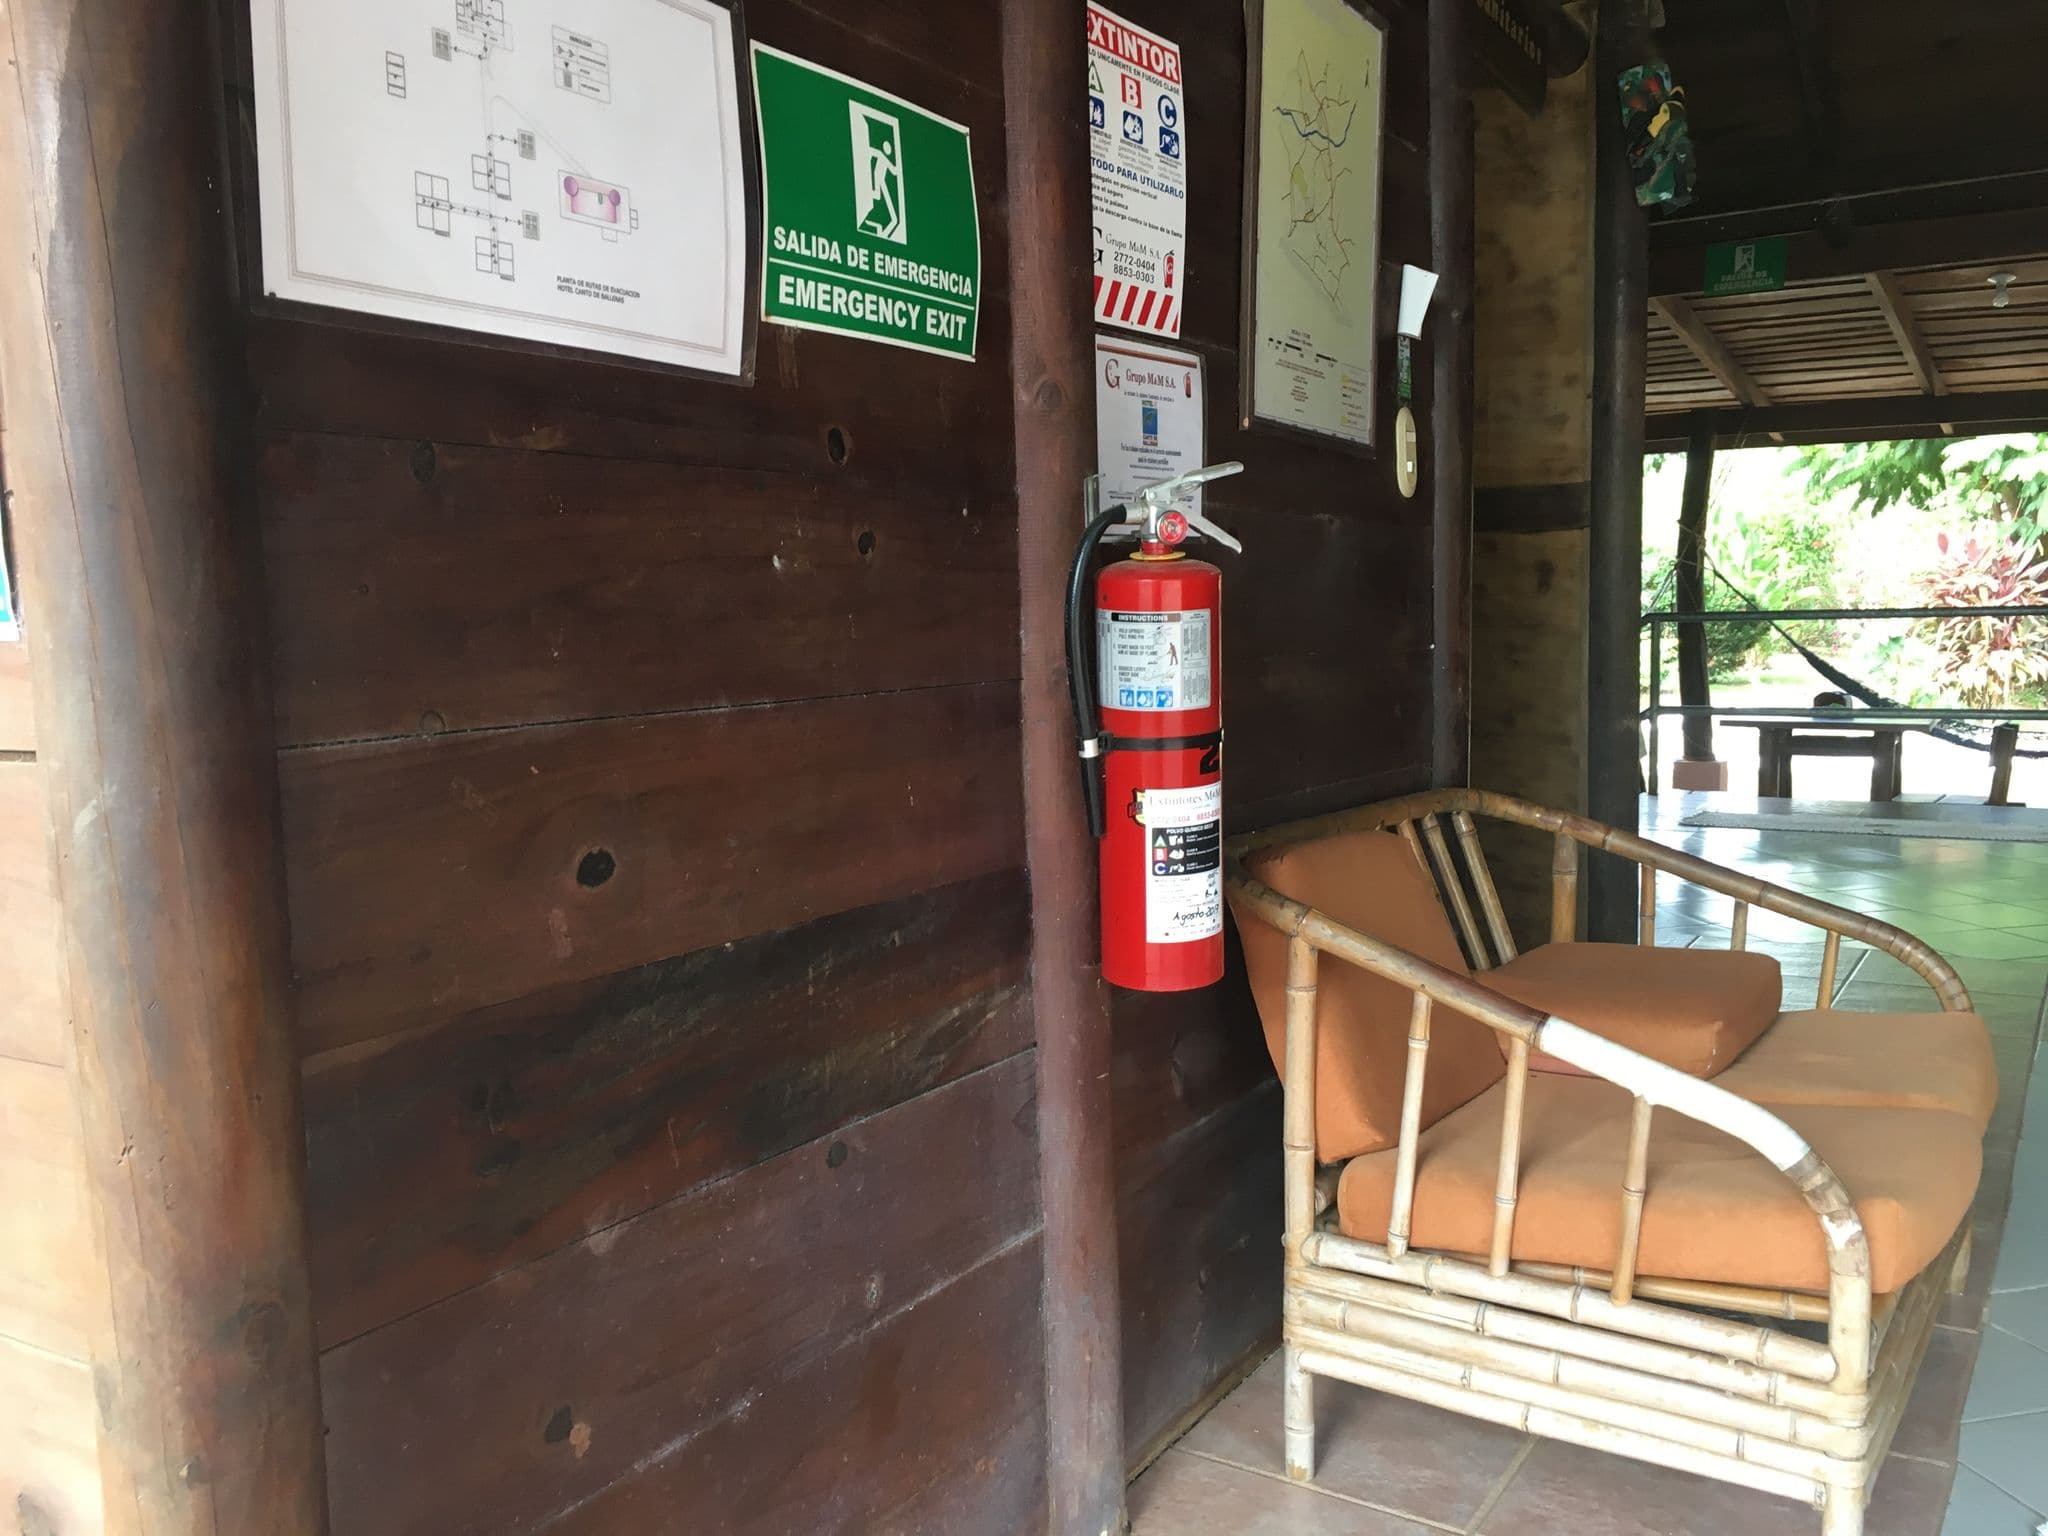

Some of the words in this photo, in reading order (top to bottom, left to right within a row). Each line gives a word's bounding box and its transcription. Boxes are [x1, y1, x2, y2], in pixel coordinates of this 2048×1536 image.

[1124, 76, 1139, 107] B
[1091, 157, 1114, 173] TODO
[1117, 166, 1138, 182] PARA
[1141, 175, 1184, 199] UTILIZARLO
[1105, 233, 1127, 251] Grupo
[773, 225, 842, 265] SALIDA
[847, 244, 870, 271] DE
[874, 251, 973, 298] EMERGENCIA
[1113, 251, 1156, 273] 2772-0404
[556, 275, 577, 285] PLANTA
[1113, 263, 1155, 285] 8853-0303
[557, 284, 574, 294] HOTEL
[575, 288, 592, 297] CANTO
[779, 273, 921, 331] EMERGENCY
[926, 307, 967, 341] EXIT
[1126, 367, 1147, 386] Grupo
[1118, 614, 1169, 623] INSTRUCTIONS
